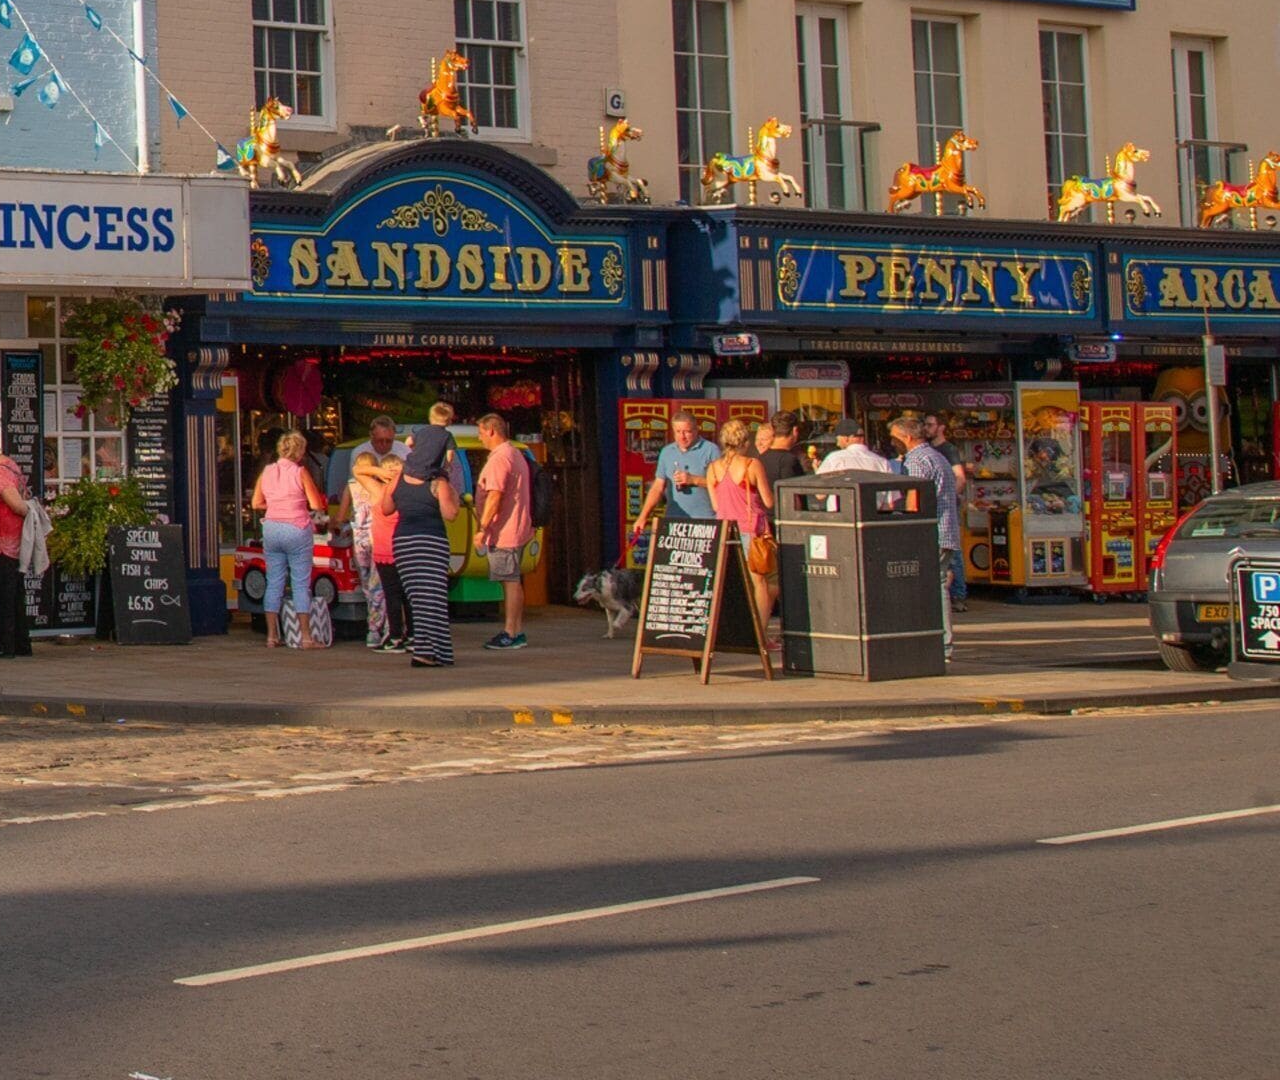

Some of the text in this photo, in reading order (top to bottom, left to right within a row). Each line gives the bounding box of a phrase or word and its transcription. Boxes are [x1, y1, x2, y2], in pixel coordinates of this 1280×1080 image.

[289, 238, 590, 292] SANDSIDE
[838, 254, 1040, 304] PENNY
[373, 334, 495, 346] JIMMY CORRIGANS
[810, 340, 963, 352] TRADITIONAL AMUSEMENTS
[1151, 347, 1185, 356] JIMMY
[12, 372, 35, 384] SENIOR
[7, 385, 36, 397] CITIZENS
[7, 424, 39, 434] SMALL FISH
[126, 530, 160, 543] SPECIAL
[668, 522, 717, 539] VEGETARIAN
[694, 540, 712, 553] FREE
[131, 549, 157, 561] SMALL
[670, 550, 703, 565] OPTIONS
[121, 563, 140, 575] FISH
[803, 565, 838, 576] LITTER
[144, 579, 168, 590] CHIPS
[1259, 576, 1276, 599] P
[128, 596, 154, 611] £6.95
[1258, 605, 1279, 617] 750
